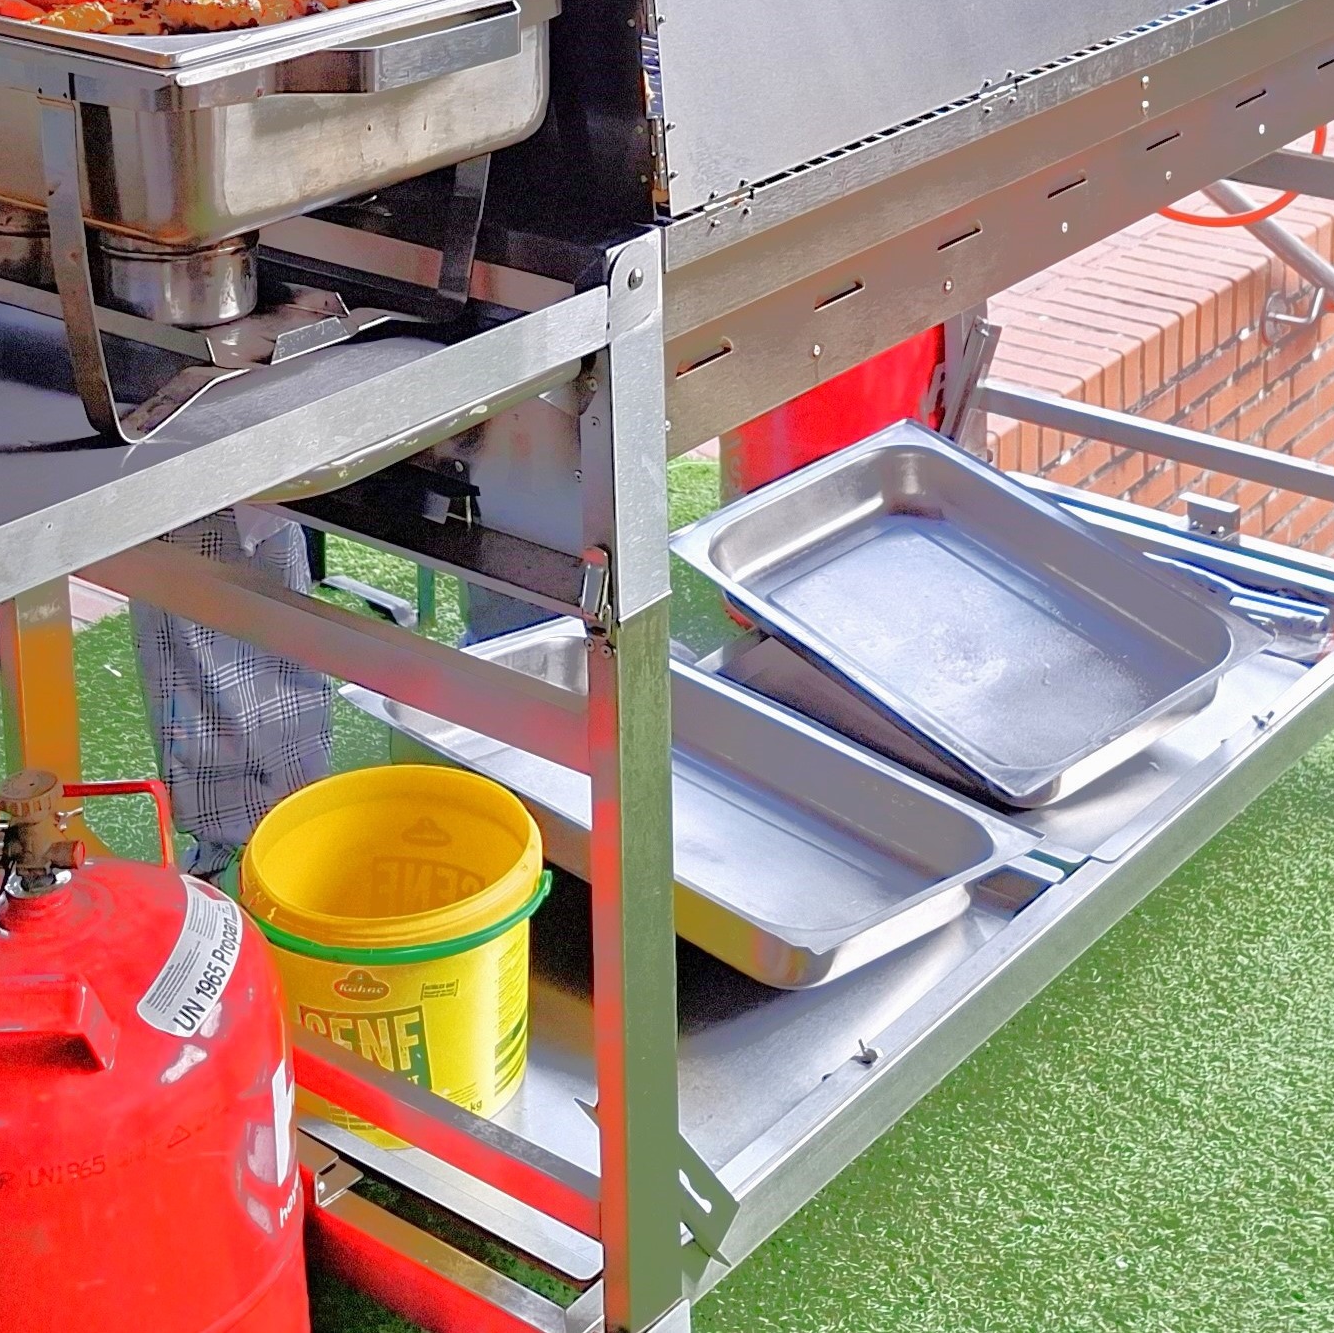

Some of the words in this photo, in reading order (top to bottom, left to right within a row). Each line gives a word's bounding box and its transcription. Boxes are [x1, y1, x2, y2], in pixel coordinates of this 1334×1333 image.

[173, 998, 206, 1032] UN
[195, 961, 227, 1000] 1965
[212, 917, 241, 966] Propan
